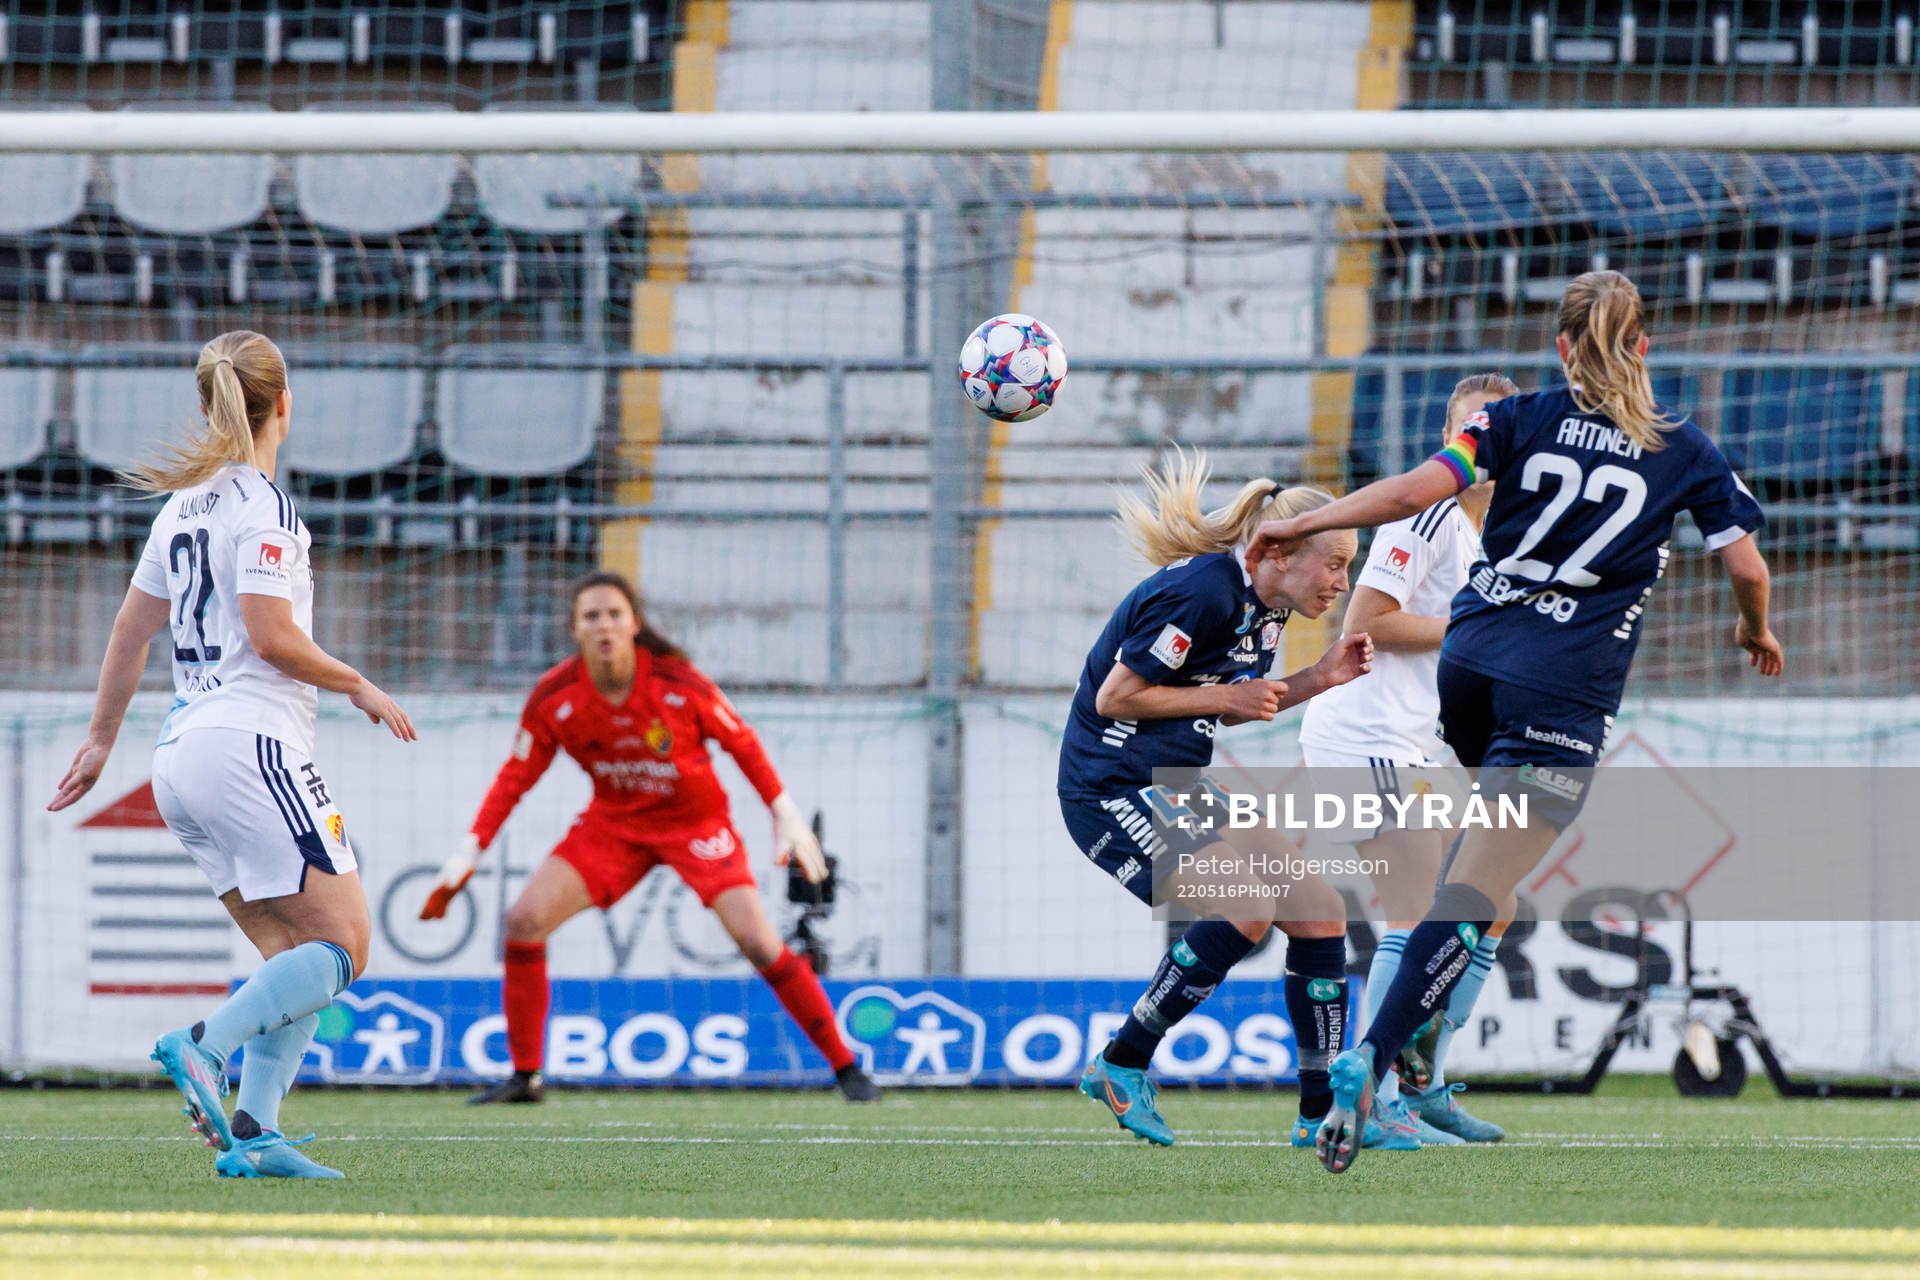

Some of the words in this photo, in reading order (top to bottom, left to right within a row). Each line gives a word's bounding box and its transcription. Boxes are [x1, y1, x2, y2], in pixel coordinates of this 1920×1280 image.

[1556, 418, 1642, 460] AHTINEN
[1494, 452, 1648, 587] 22
[1525, 726, 1594, 754] healthcare
[1420, 949, 1470, 1009] LUNDBERGS
[1327, 1004, 1342, 1064] LUNDBER
